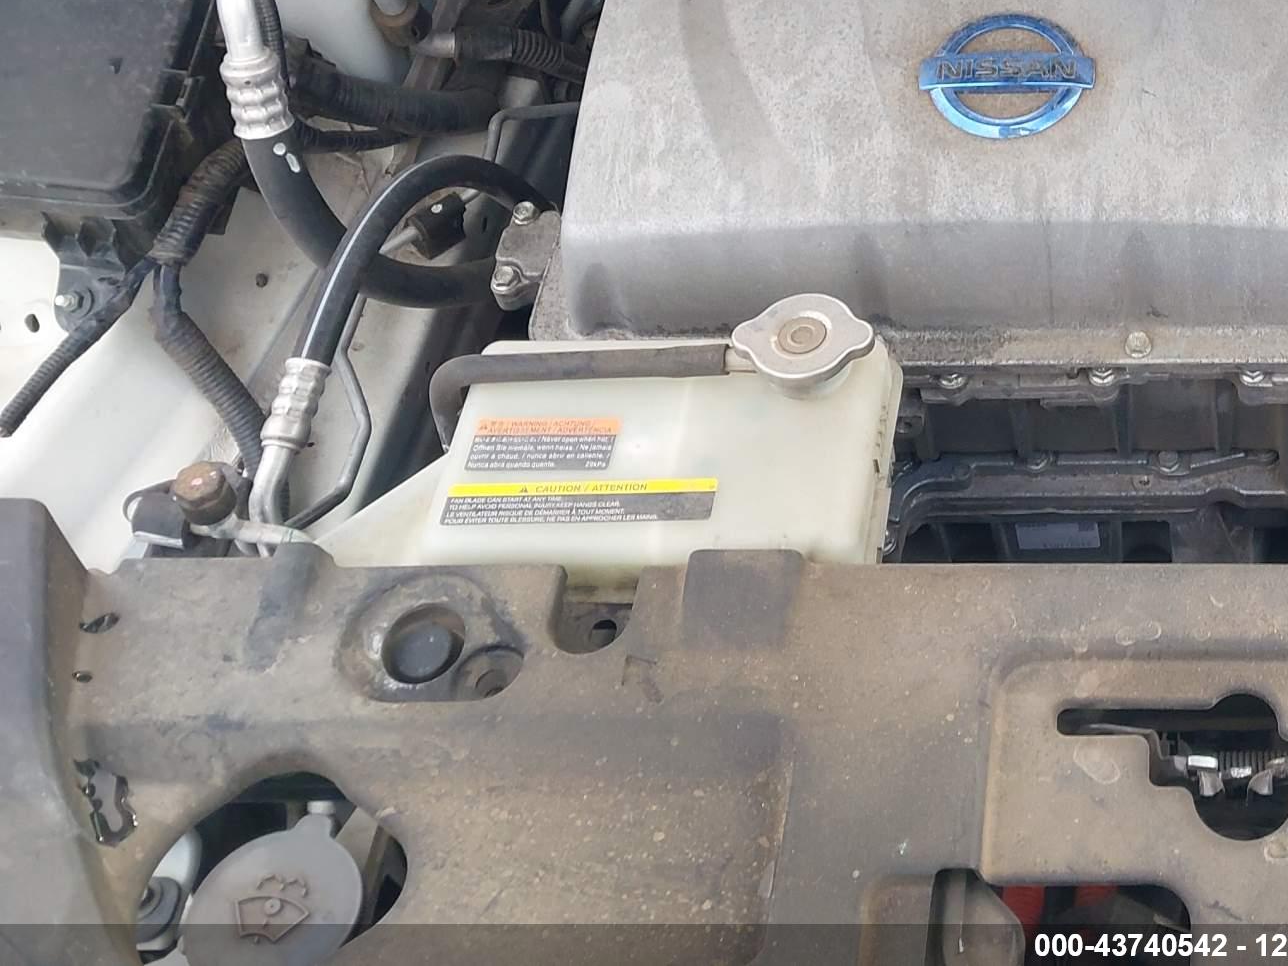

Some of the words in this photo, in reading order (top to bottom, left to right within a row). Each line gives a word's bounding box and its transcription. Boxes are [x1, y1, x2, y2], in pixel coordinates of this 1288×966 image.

[937, 56, 1077, 81] NISSAN
[467, 460, 489, 468] Nunca
[535, 485, 581, 493] CAUTION
[591, 483, 648, 491] ATTENTION
